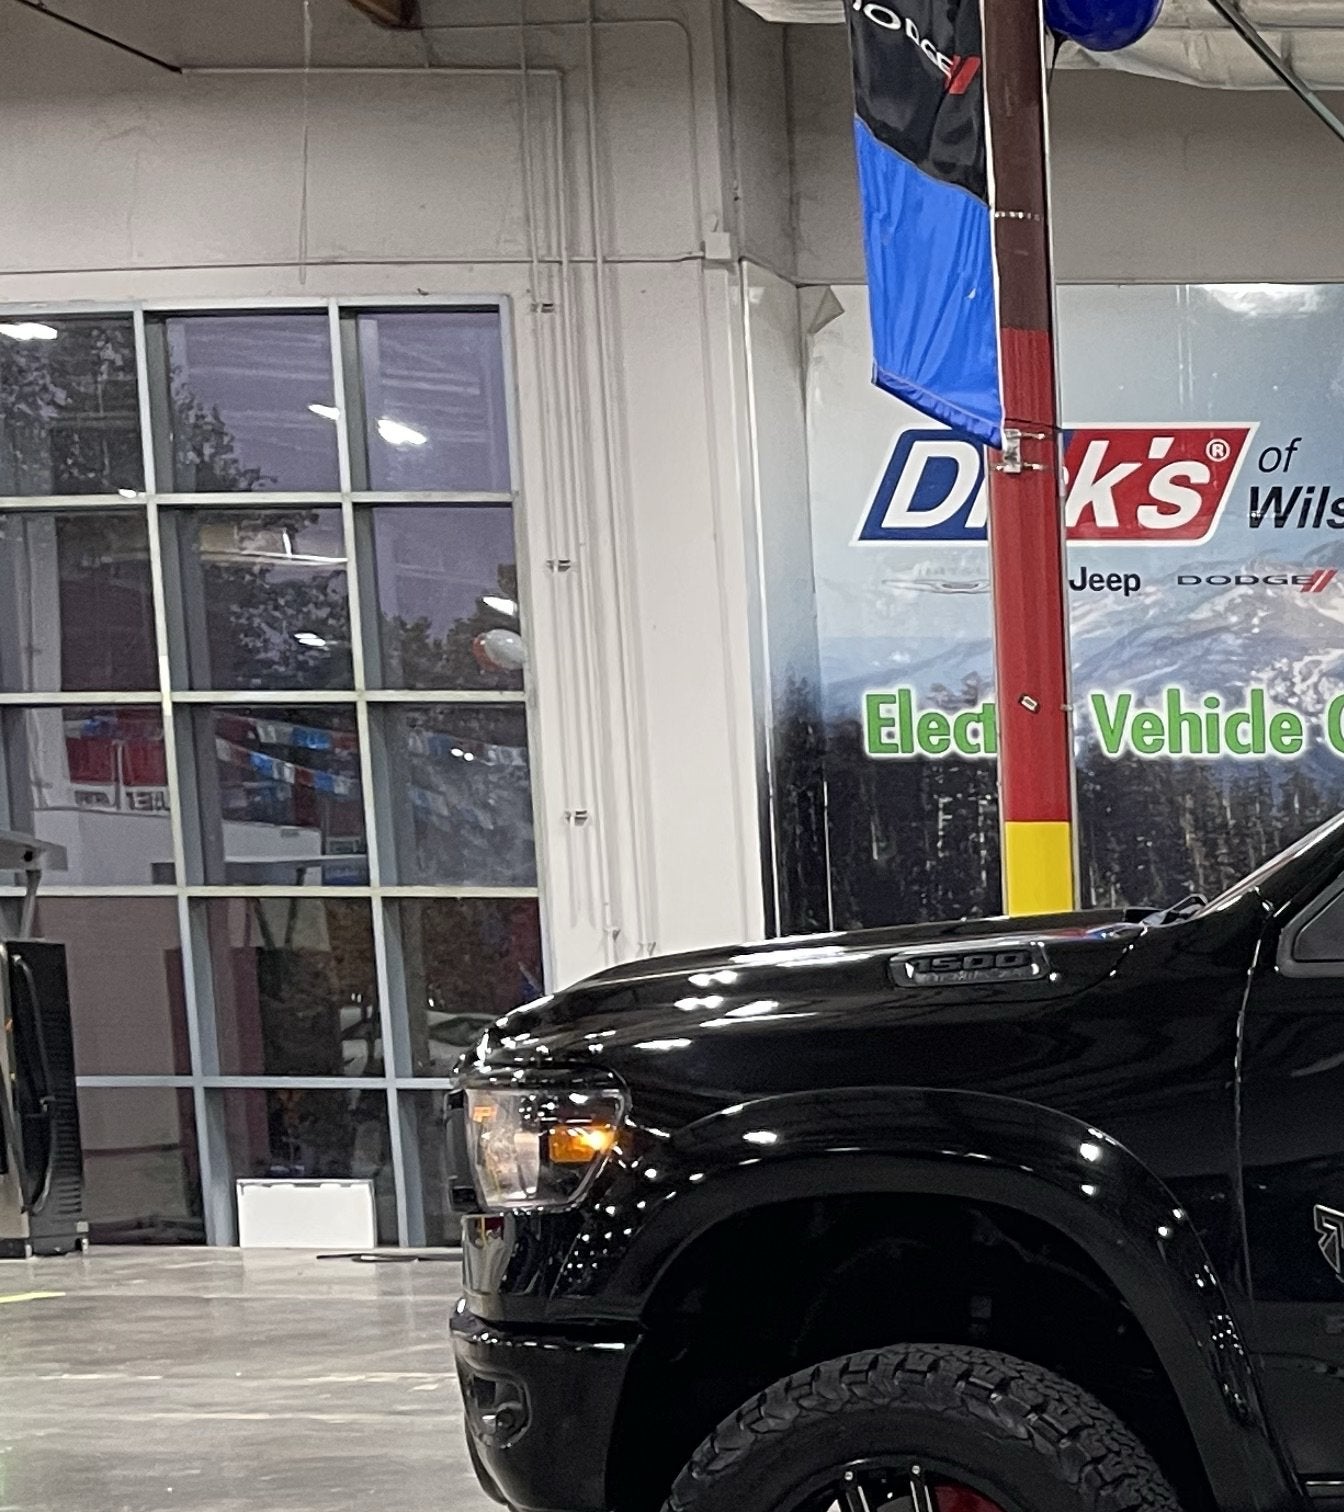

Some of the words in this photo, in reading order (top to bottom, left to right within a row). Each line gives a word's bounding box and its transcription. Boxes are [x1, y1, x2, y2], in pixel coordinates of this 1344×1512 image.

[852, 0, 954, 80] ODGE
[1258, 437, 1302, 473] of
[881, 437, 1210, 529] Dk's
[1069, 567, 1142, 596] Jeep
[1177, 575, 1314, 586] DODGE
[1091, 688, 1303, 754] Vehicle
[907, 950, 1030, 973] 1500
